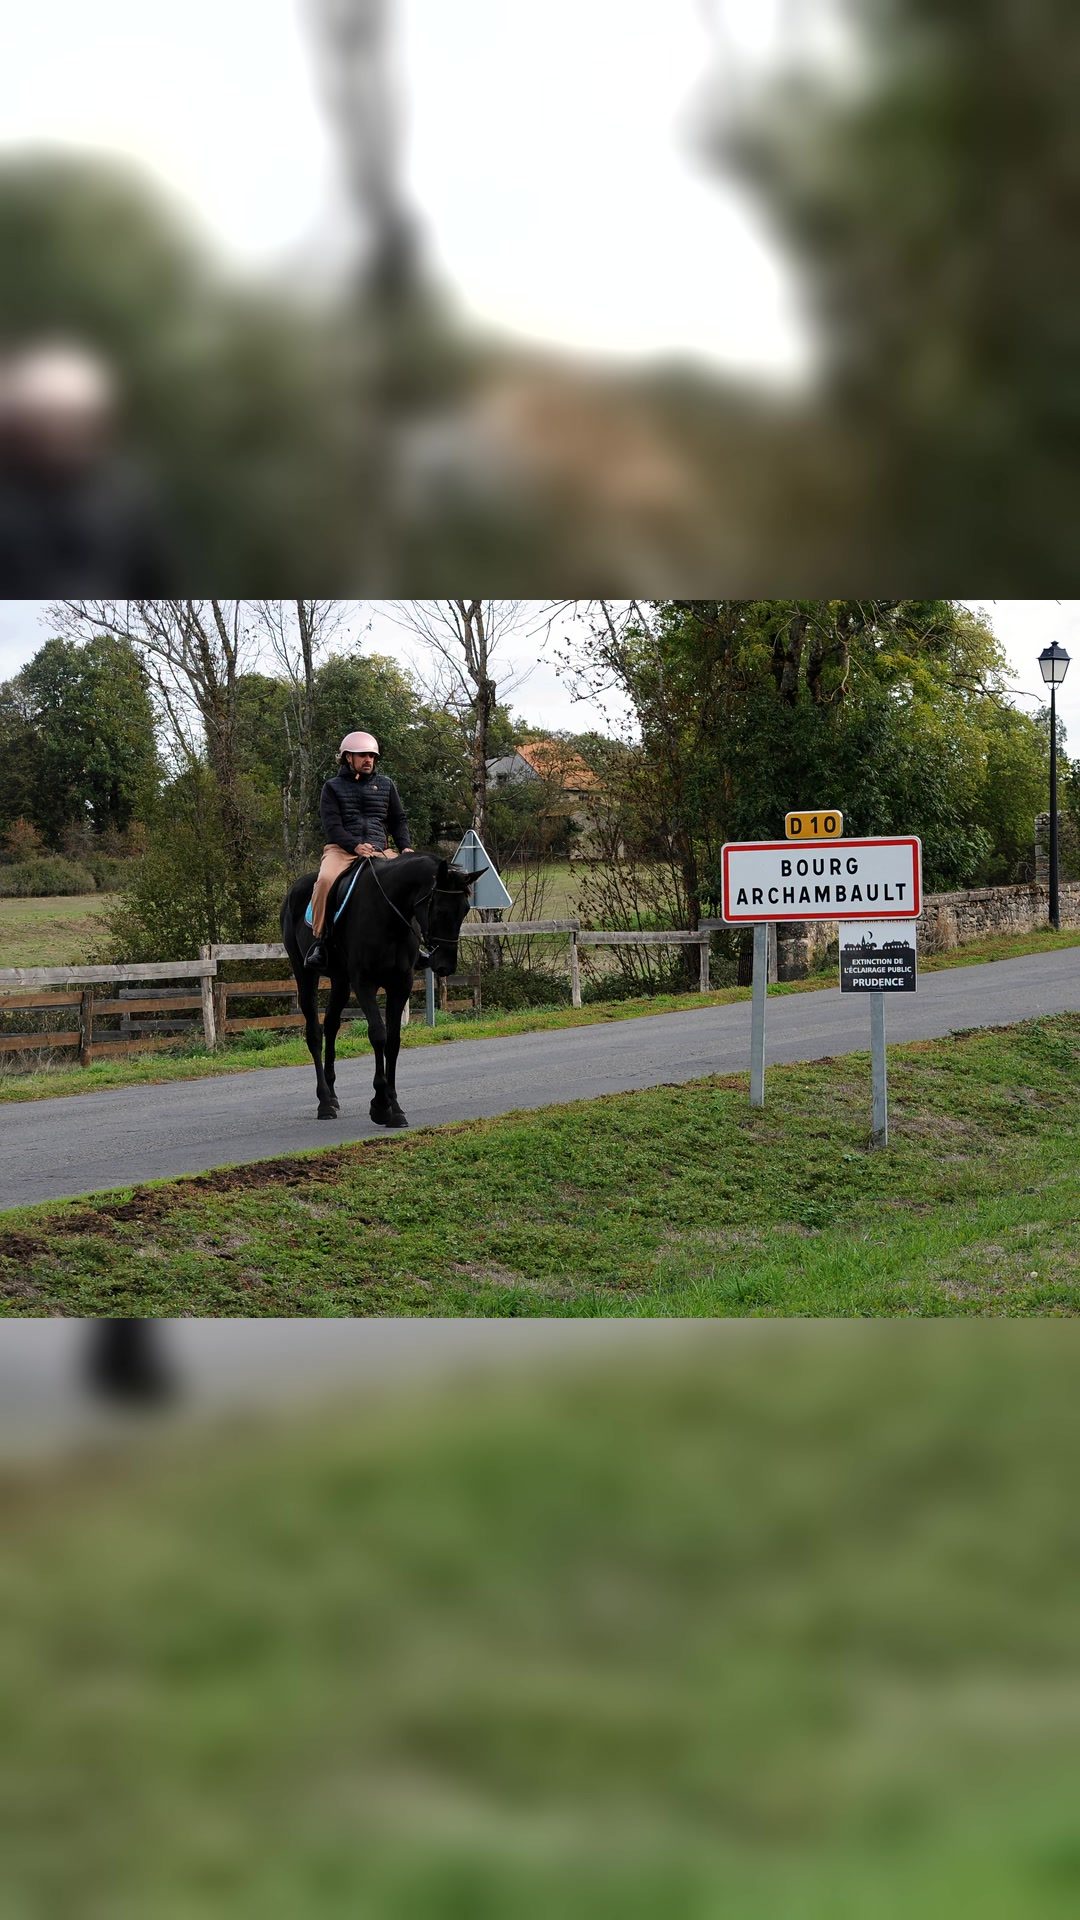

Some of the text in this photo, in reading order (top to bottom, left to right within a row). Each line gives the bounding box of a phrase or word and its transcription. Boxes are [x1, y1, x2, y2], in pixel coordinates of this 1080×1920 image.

[790, 815, 837, 835] D 10
[781, 857, 859, 877] BOURG
[736, 882, 907, 905] ARCHAMBAULT
[852, 958, 892, 966] EXTINCTION
[844, 965, 886, 974] L'ÉCLAIRAGE
[853, 978, 904, 987] PRUDENCE
